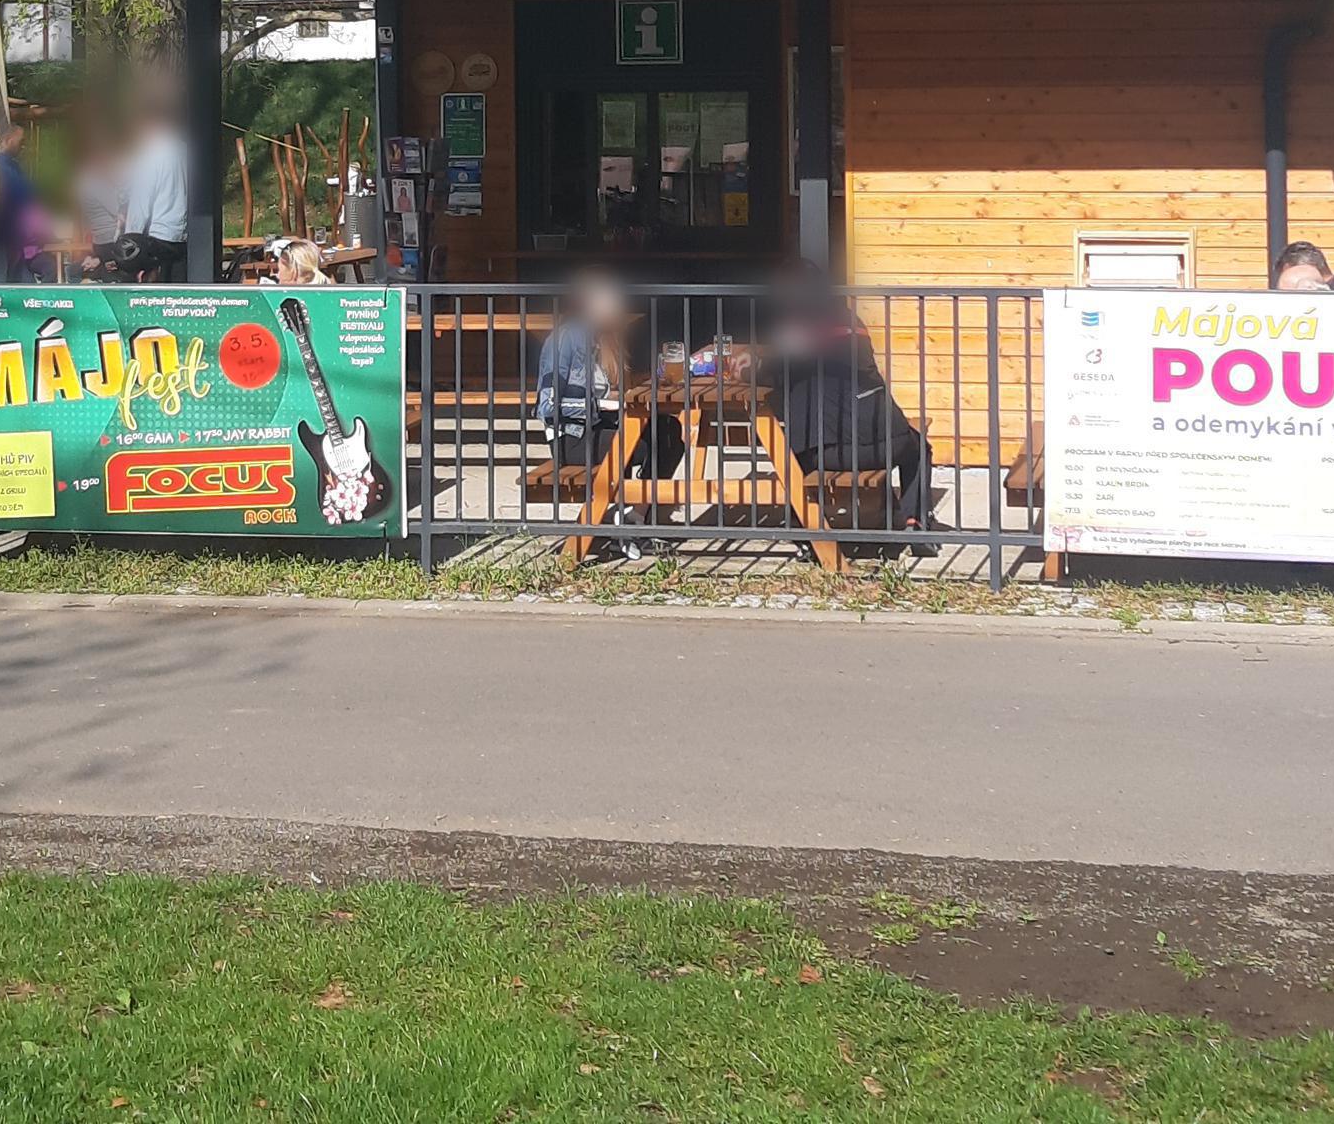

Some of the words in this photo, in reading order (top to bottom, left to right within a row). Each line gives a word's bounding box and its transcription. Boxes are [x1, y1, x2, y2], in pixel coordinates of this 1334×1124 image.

[162, 308, 189, 317] VSTUP
[190, 307, 217, 317] VOLNÝ
[340, 322, 384, 330] FESTIVALU
[1151, 303, 1319, 346] Májová
[230, 337, 246, 351] 3.
[251, 333, 267, 348] 5.
[118, 337, 212, 430] fest
[1152, 417, 1165, 431] a
[1175, 414, 1323, 439] odemykání
[145, 432, 174, 444] GAIA
[223, 429, 246, 441] JAY
[248, 427, 292, 439] RABBIT
[18, 454, 35, 464] PIV
[105, 444, 296, 514] FOCUS
[244, 508, 297, 524] ROCK
